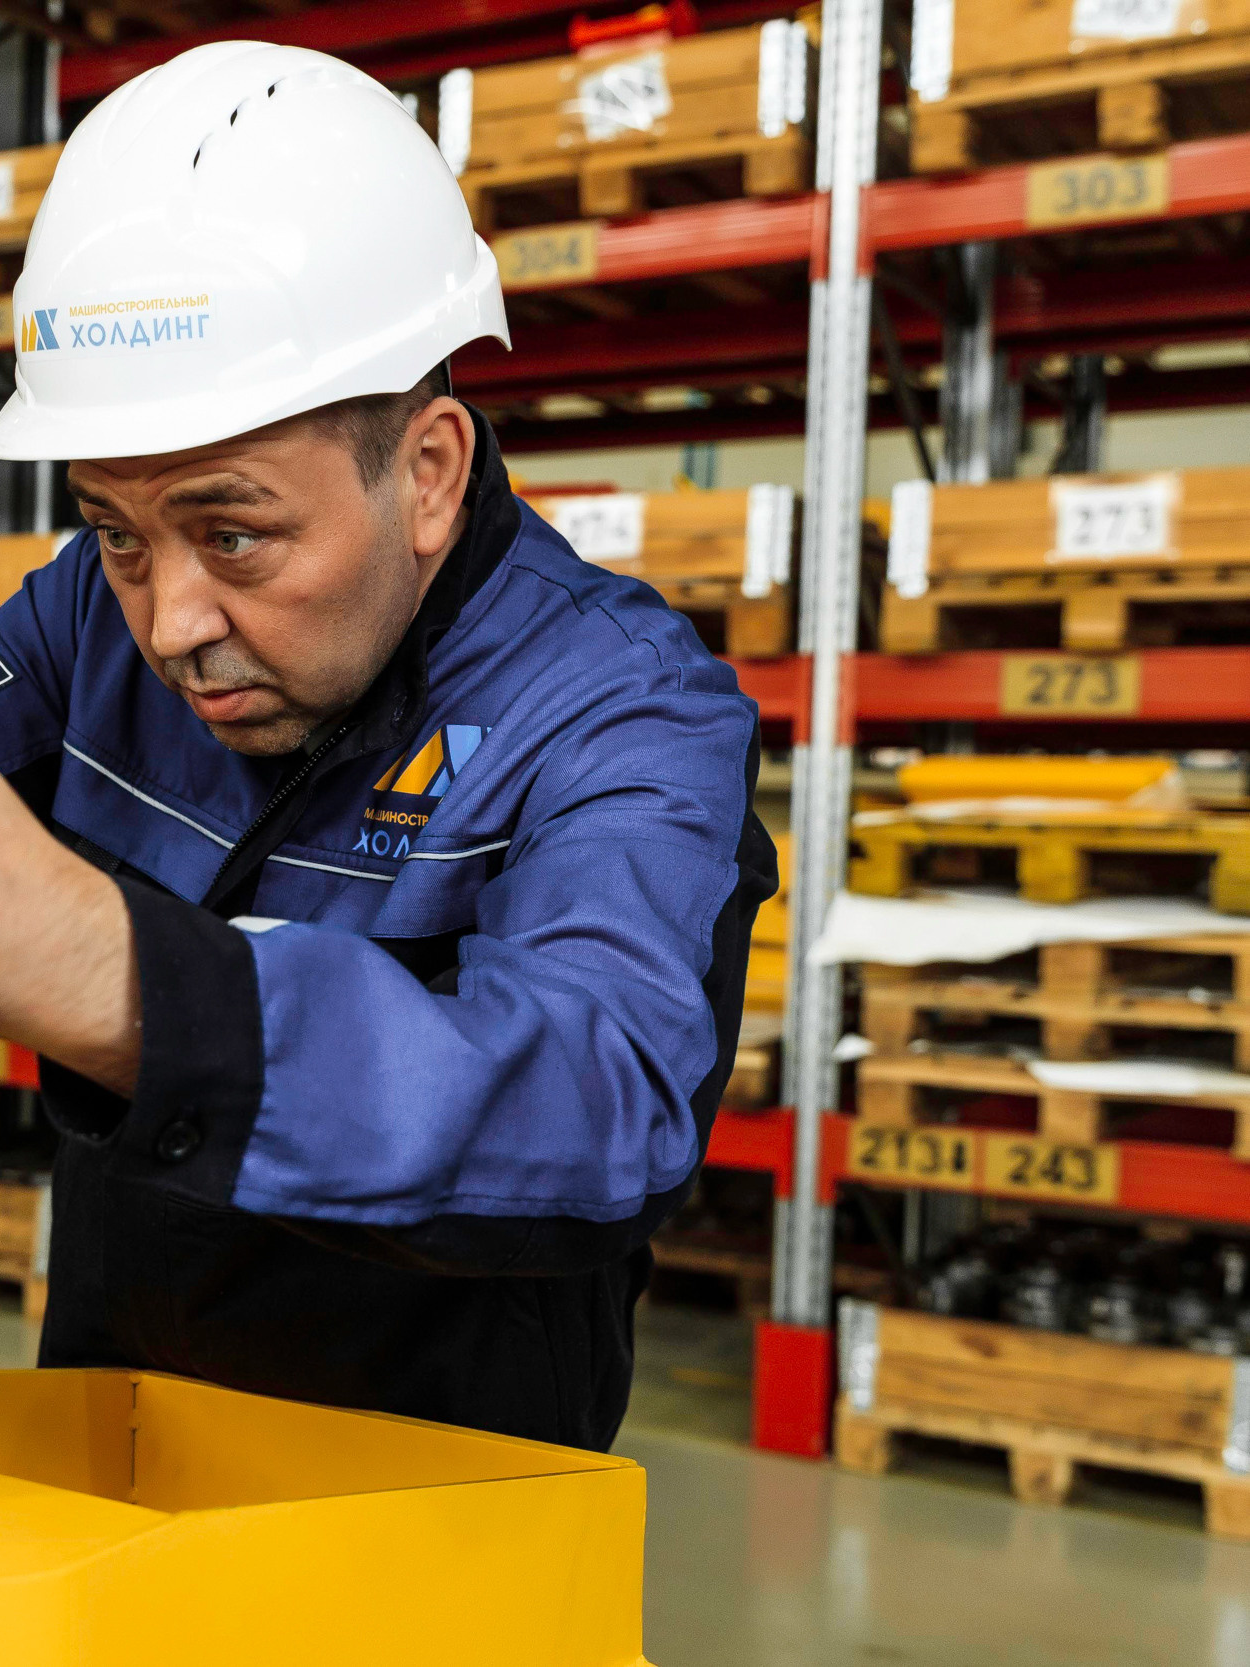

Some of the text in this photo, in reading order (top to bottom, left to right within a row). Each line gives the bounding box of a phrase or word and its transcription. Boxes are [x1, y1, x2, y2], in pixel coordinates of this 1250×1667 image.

[1054, 159, 1147, 215] 303
[69, 293, 209, 317] МАШИНОСТРОИТЕЛЬНЫЙ
[70, 314, 210, 348] ХОЛДИНГ
[1073, 502, 1154, 546] 273
[1027, 660, 1120, 706] 273
[363, 807, 429, 827] МШИНОСТР
[1005, 1144, 1097, 1193] 243
